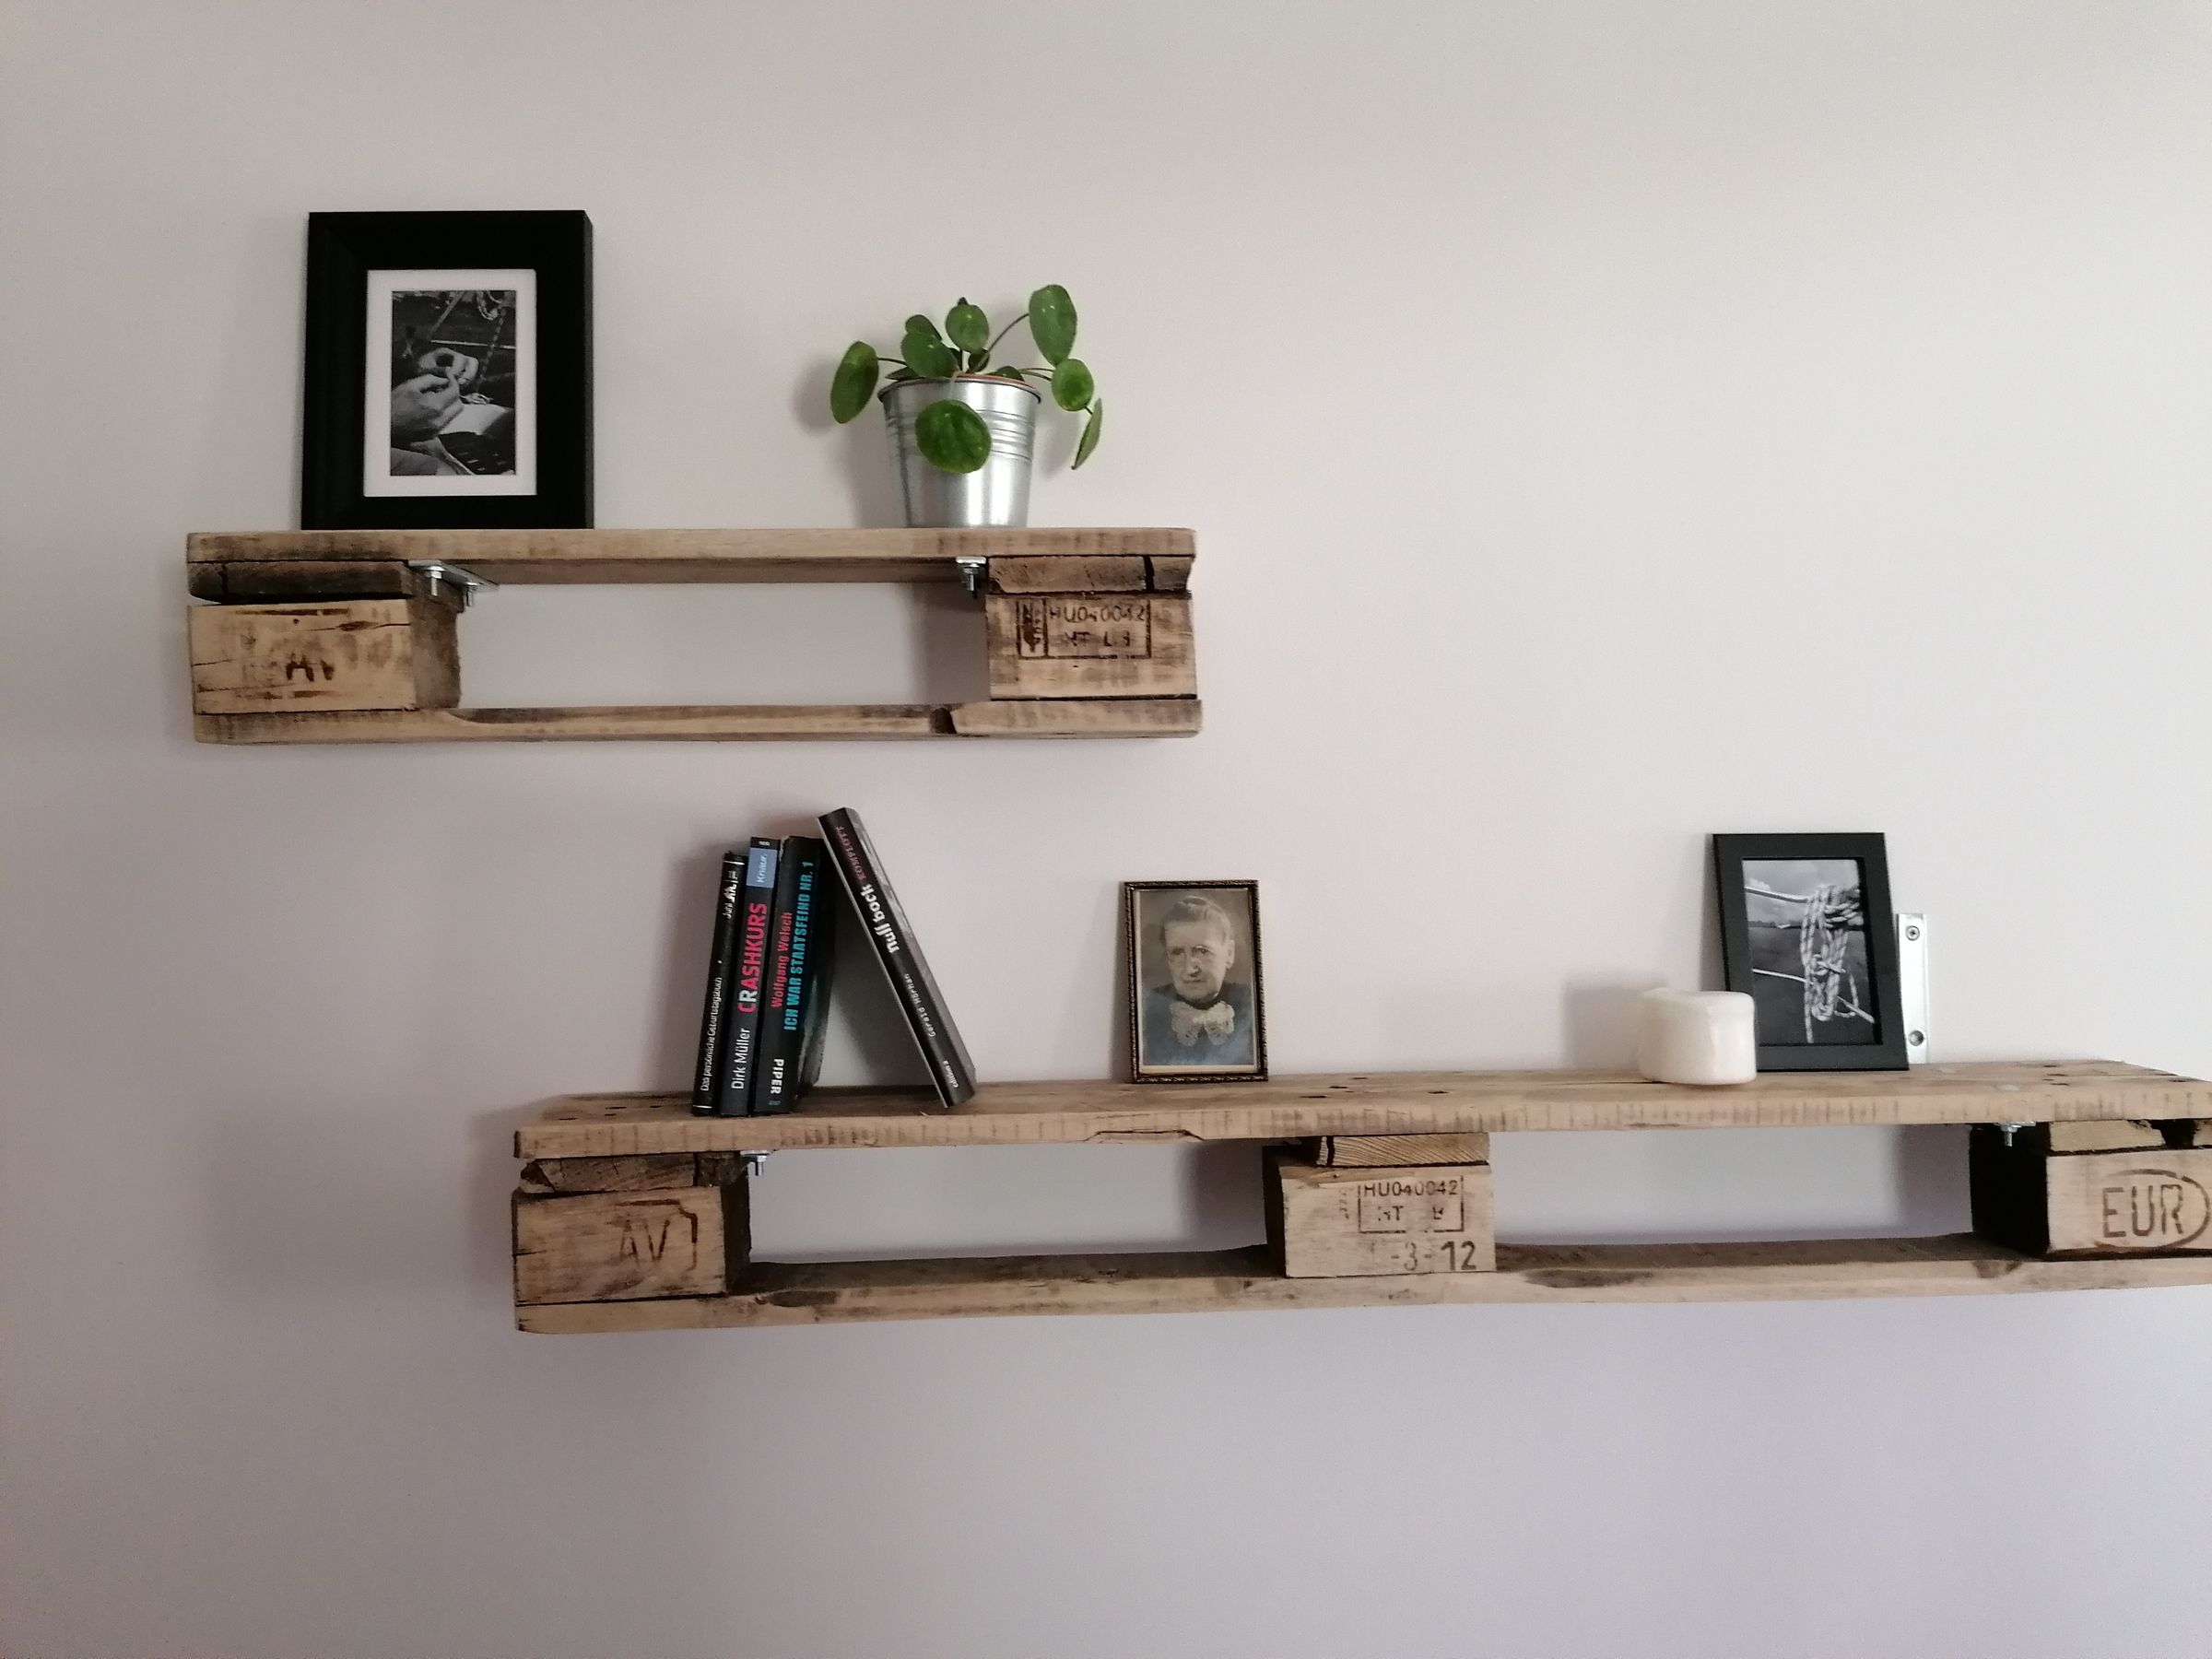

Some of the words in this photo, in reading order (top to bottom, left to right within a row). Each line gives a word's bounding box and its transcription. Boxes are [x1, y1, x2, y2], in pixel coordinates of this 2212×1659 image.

[800, 870, 813, 892] NR.
[860, 884, 886, 922] bock
[777, 912, 793, 951] Welsch
[791, 893, 811, 973] STAATSFEIND
[875, 923, 900, 953] null
[738, 903, 767, 1013] CRASHKURS
[770, 955, 790, 1008] Wolfgang
[786, 974, 801, 1005] WAR
[783, 1006, 797, 1030] ICH
[915, 1005, 935, 1037] Gerald
[702, 1034, 717, 1077] persönliche
[735, 1028, 751, 1061] Müller
[732, 1062, 746, 1089] Dirk
[770, 1058, 783, 1094] PIPER
[2102, 1184, 2184, 1238] EUR
